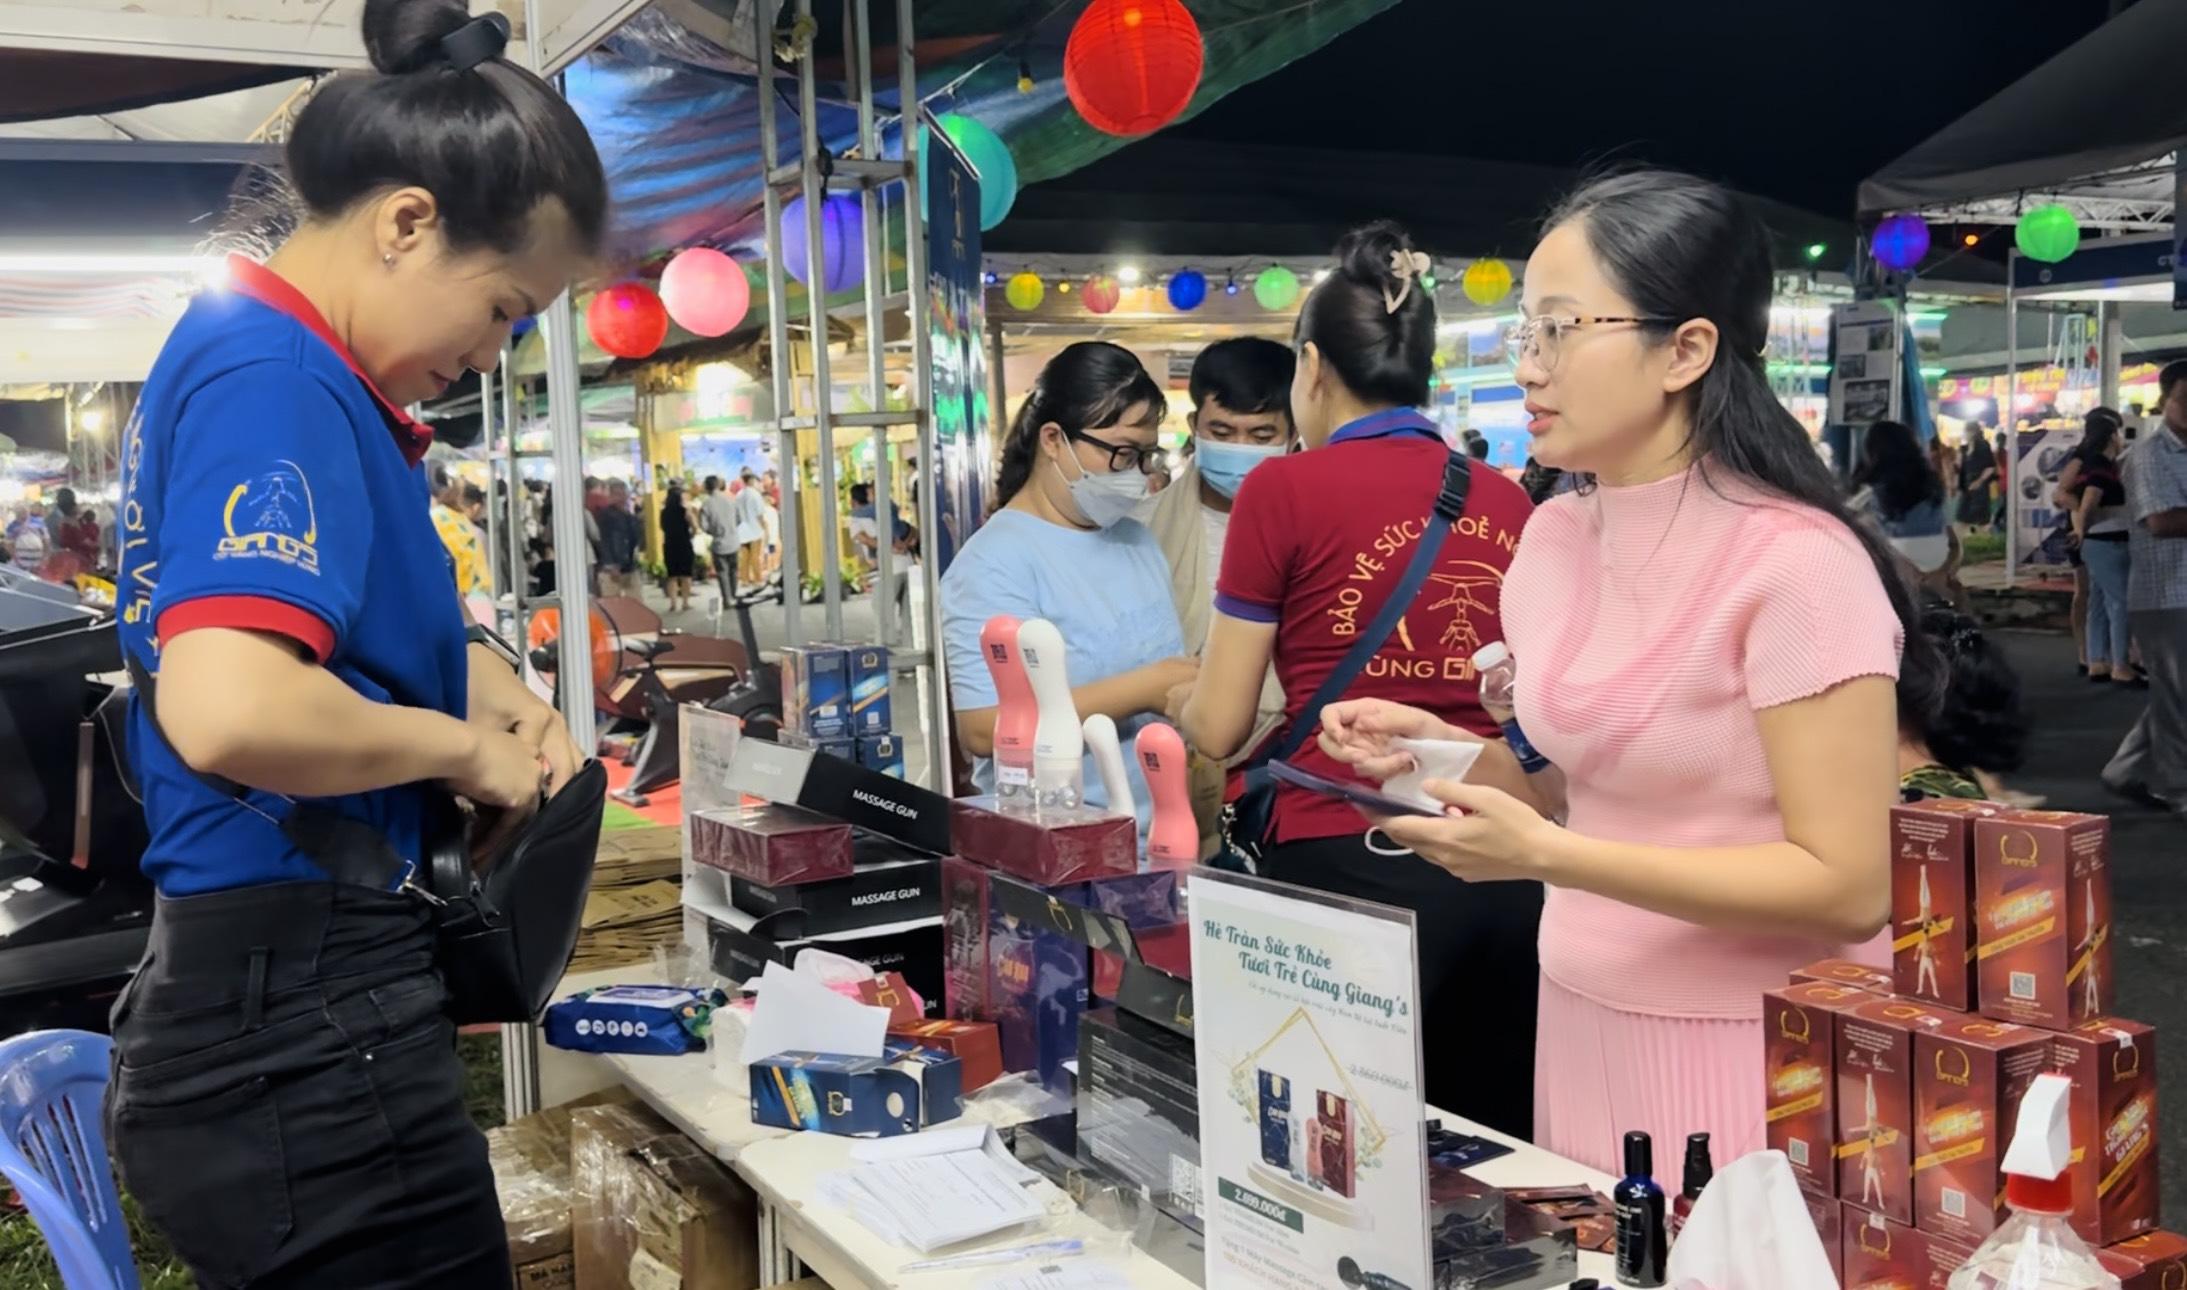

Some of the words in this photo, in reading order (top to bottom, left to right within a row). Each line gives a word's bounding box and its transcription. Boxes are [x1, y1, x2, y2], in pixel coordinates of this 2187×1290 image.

[1327, 587, 1363, 635] BẢO
[1348, 552, 1386, 582] VỆ
[1366, 655, 1435, 679] ÙNG
[852, 789, 897, 813] MASSAGE
[896, 804, 919, 820] GUN
[851, 890, 897, 906] MASSAGE
[898, 888, 920, 900] GUN
[1203, 919, 1222, 941] Hè
[1226, 926, 1260, 950] Tràn
[1264, 935, 1291, 958] Sức
[1294, 944, 1332, 970] Khỏe
[1274, 961, 1298, 984] Trẻ
[1302, 969, 1341, 1001] Cùng
[1345, 982, 1408, 1018] Giang's
